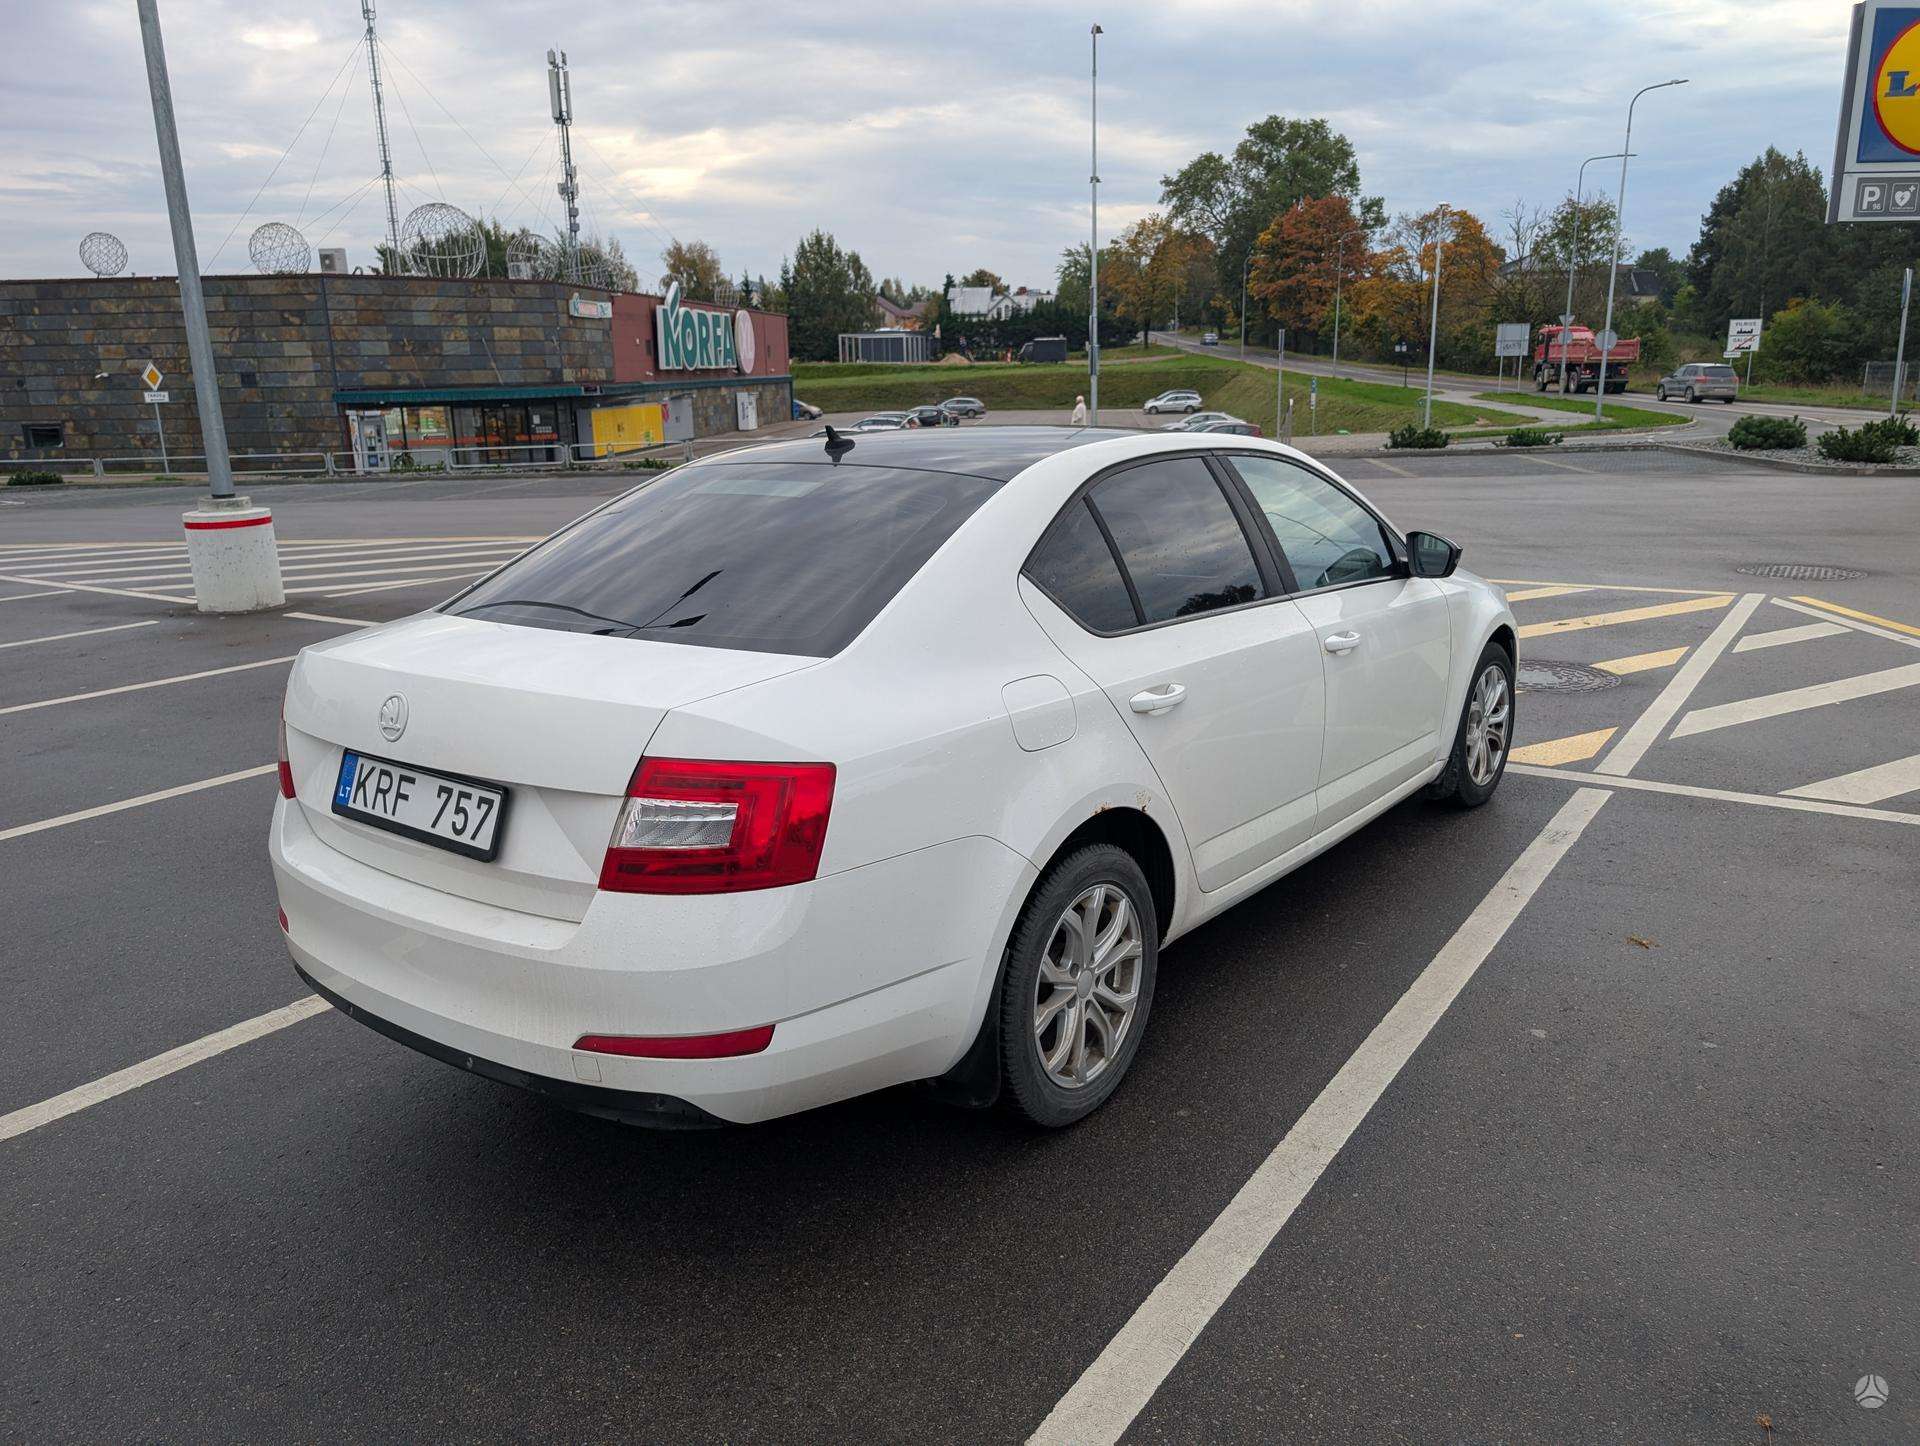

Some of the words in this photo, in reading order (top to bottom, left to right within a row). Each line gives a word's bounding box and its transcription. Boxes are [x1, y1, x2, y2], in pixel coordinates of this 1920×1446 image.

[1884, 70, 1920, 98] L
[1862, 186, 1881, 210] P
[658, 286, 736, 369] NORFA
[338, 785, 352, 799] LT
[352, 762, 417, 817] KRF
[430, 784, 496, 842] 757
